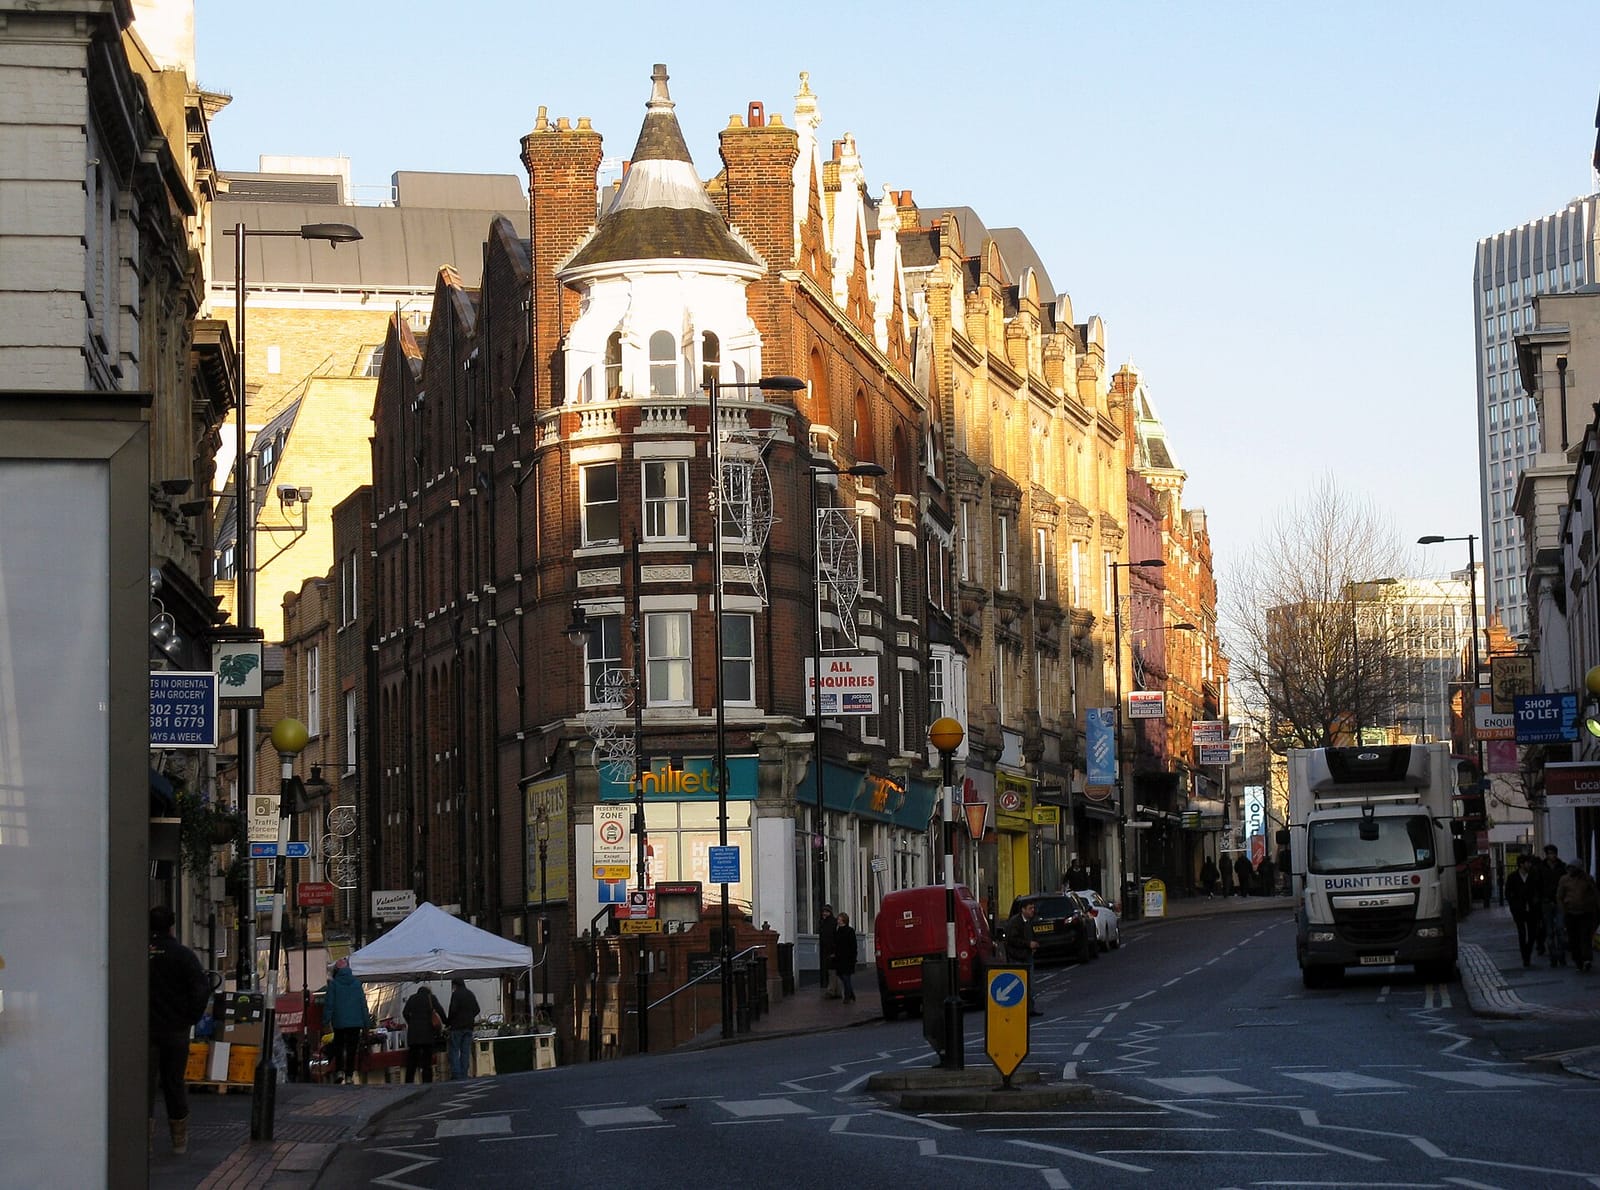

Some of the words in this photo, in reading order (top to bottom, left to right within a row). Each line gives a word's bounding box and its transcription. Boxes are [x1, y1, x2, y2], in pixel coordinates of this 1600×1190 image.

[831, 661, 852, 672] ALL
[161, 680, 169, 688] IN
[171, 680, 208, 689] ORIENTAL
[809, 676, 875, 687] ENQUIRIES
[168, 690, 205, 699] GROCERY
[1525, 699, 1552, 709] SHOP
[176, 705, 205, 715] 5731
[1518, 709, 1535, 720] TO
[1538, 708, 1559, 719] LET
[174, 717, 205, 727] 6779
[151, 733, 168, 741] AYS
[170, 733, 176, 741] A
[178, 733, 202, 741] WEEK
[1325, 877, 1373, 890] BURNT
[1375, 874, 1409, 886] TREE
[1358, 899, 1390, 907] DAF
